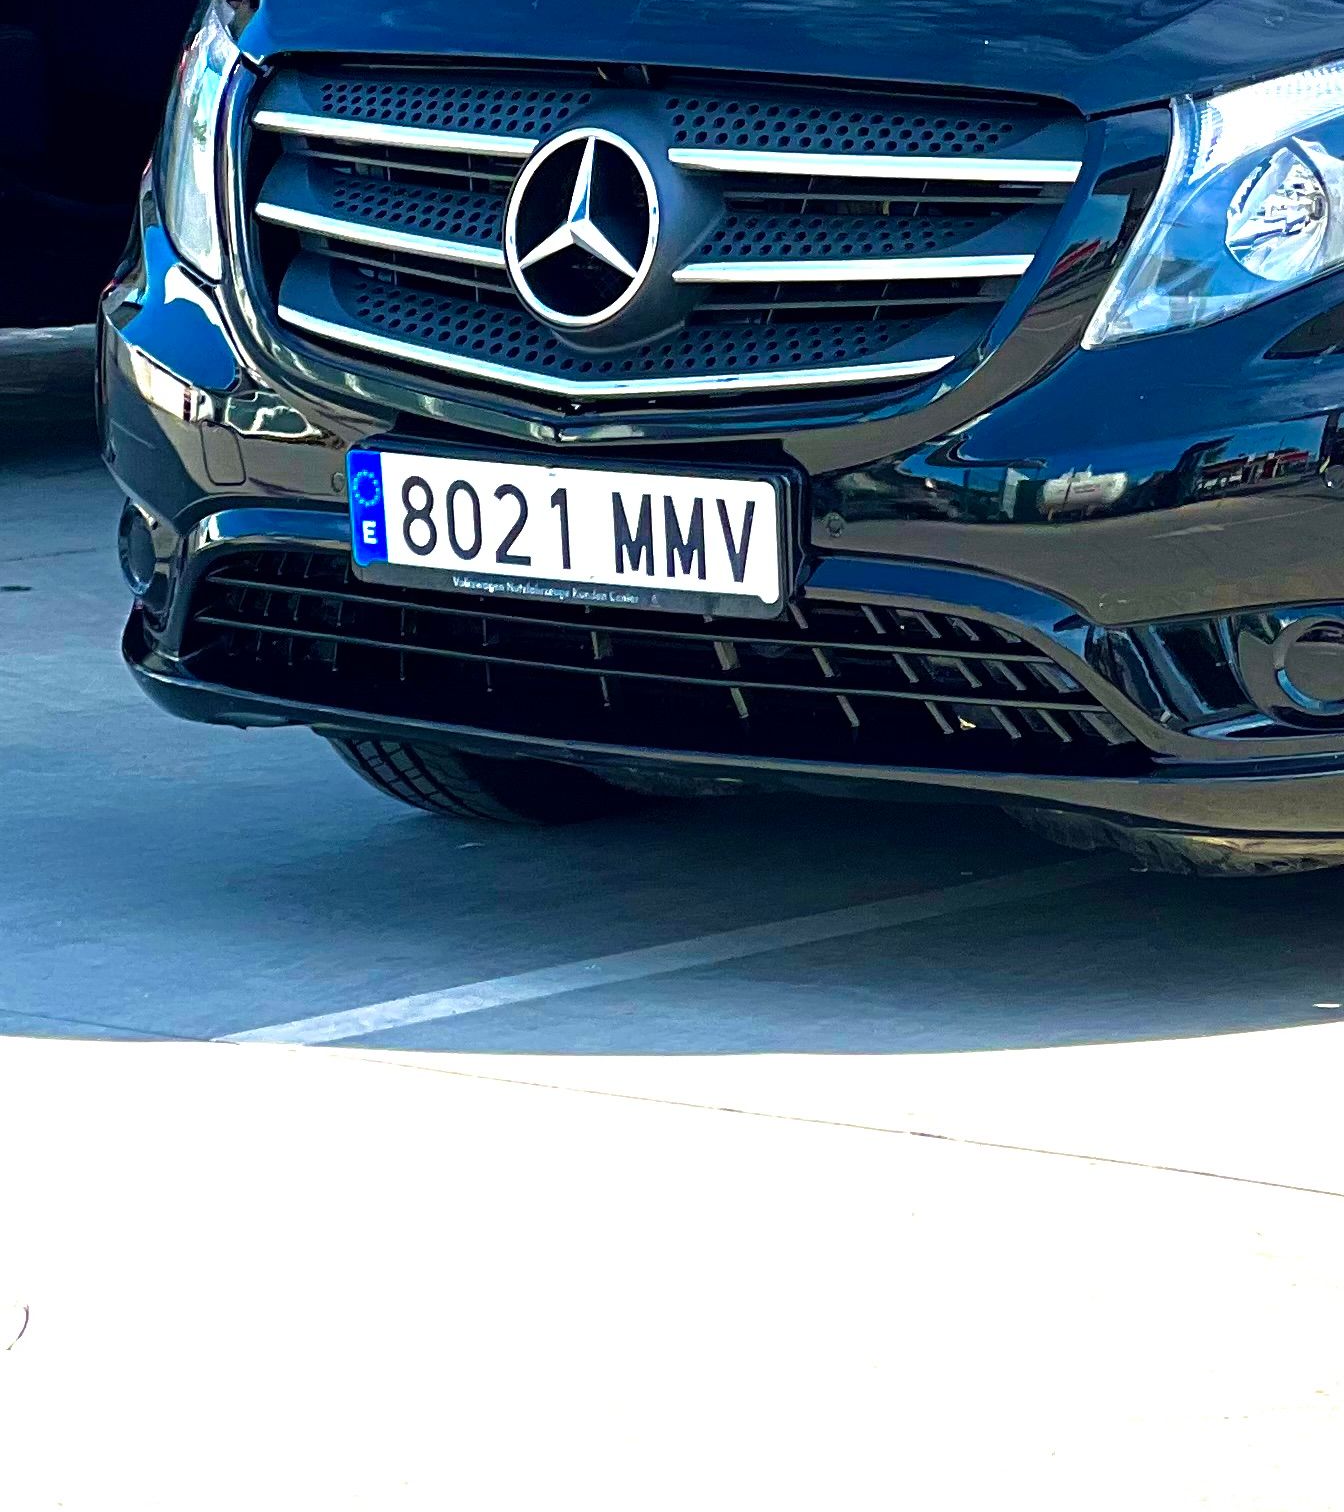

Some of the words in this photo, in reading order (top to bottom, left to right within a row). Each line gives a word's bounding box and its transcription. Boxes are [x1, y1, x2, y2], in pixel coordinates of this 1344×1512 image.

[362, 520, 378, 545] E
[401, 474, 572, 571] 8021
[611, 491, 757, 583] MMV
